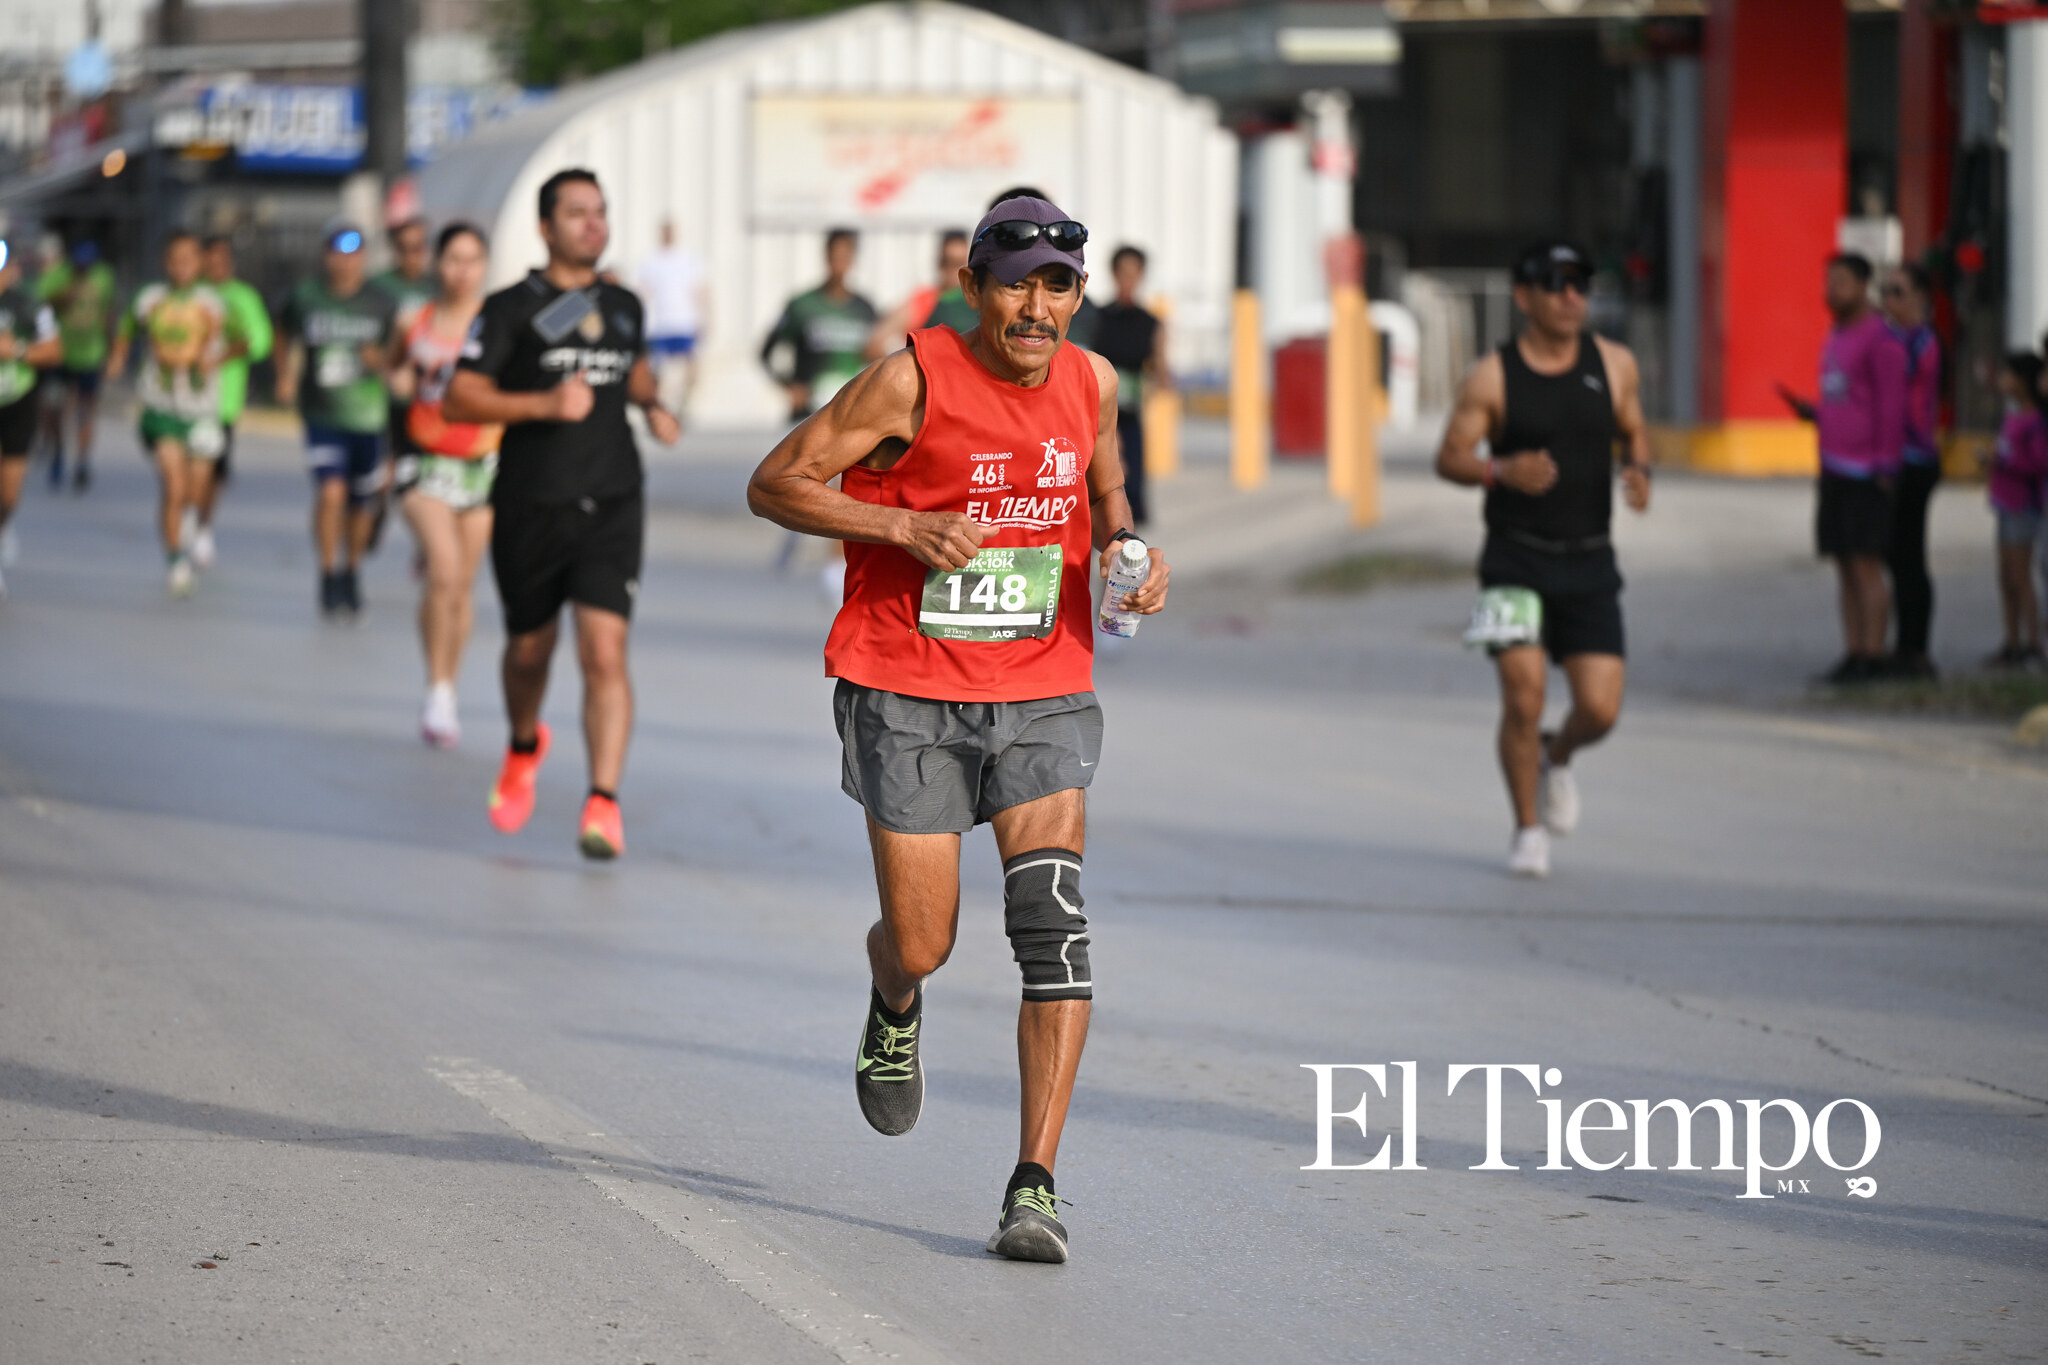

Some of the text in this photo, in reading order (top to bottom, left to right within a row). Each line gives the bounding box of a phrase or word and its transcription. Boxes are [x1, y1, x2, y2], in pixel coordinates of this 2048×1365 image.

[970, 452, 1013, 462] CELEBRANDO
[1055, 452, 1070, 476] 10K
[971, 463, 997, 485] 46
[997, 463, 1005, 486] AÑOS
[1037, 473, 1077, 488] RETO TIEMPO
[977, 484, 1013, 493] INFORMACIÓN
[966, 495, 1077, 522] EL TIEMPO
[978, 550, 1015, 558] RRERA
[1049, 552, 1060, 560] 148
[945, 574, 1027, 612] 148
[1044, 567, 1059, 627] MEDALLA
